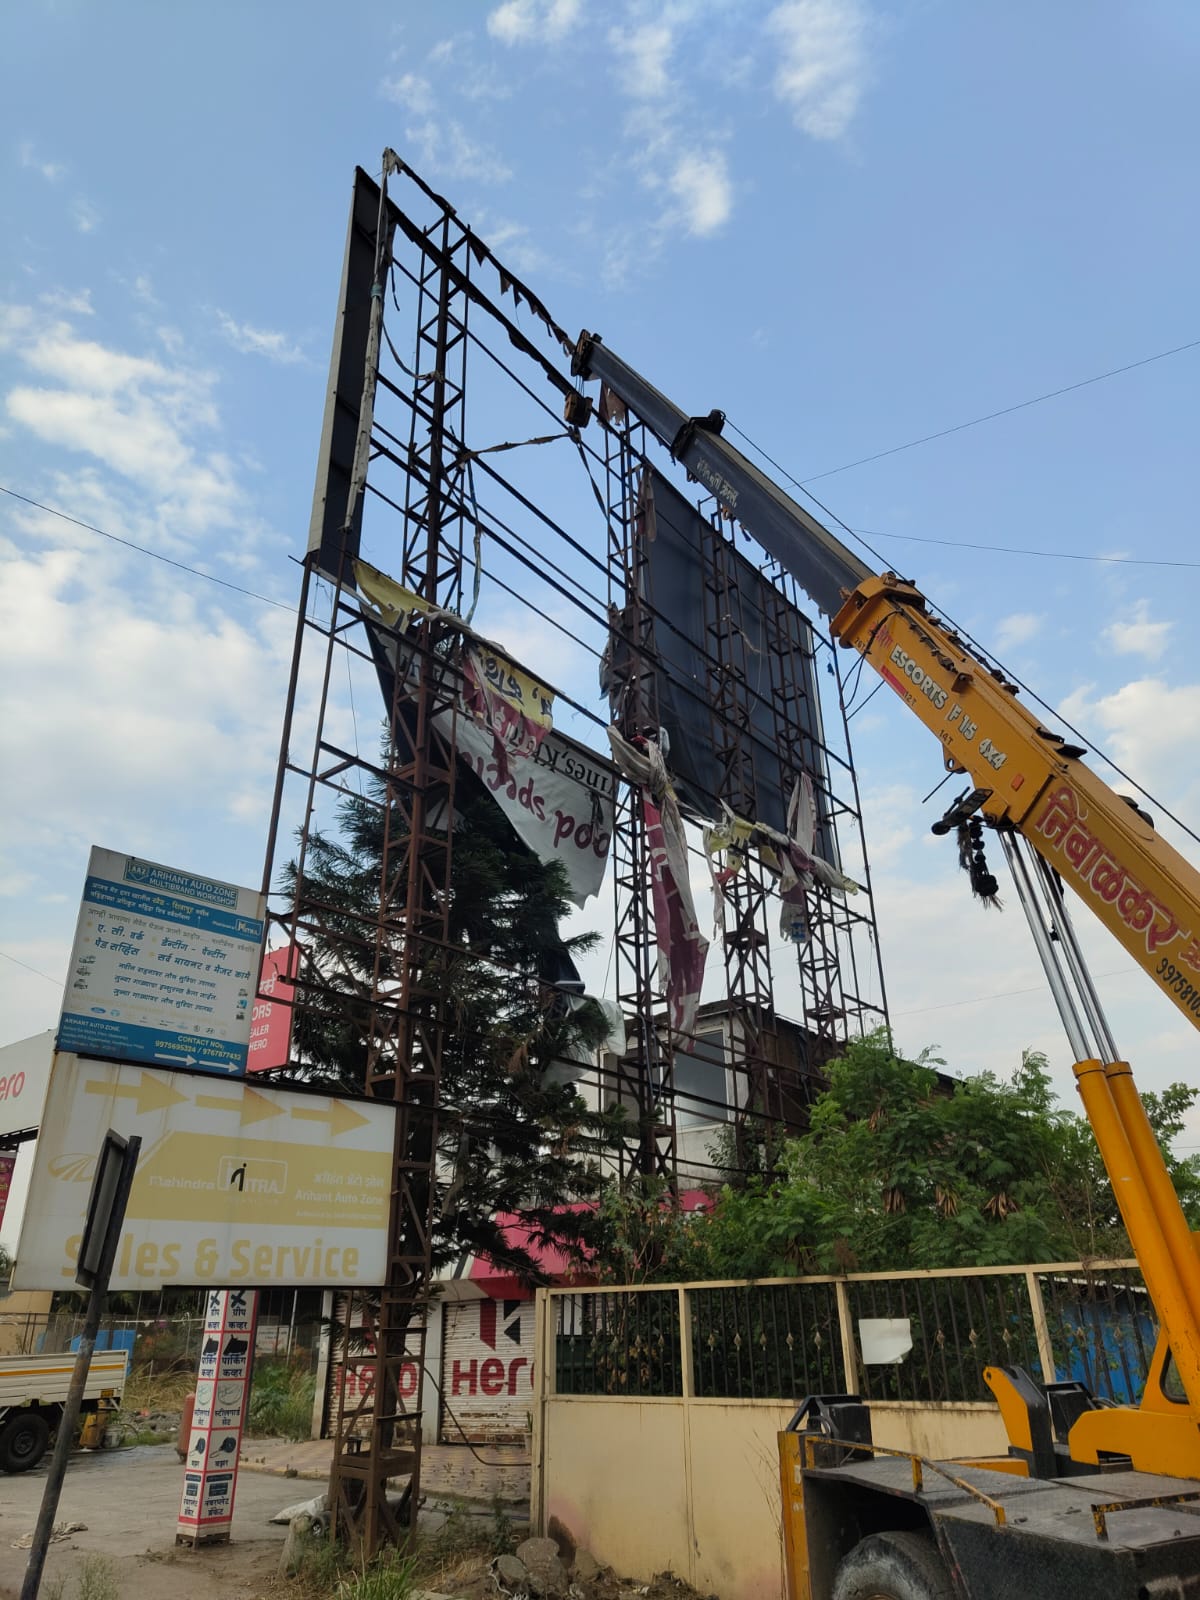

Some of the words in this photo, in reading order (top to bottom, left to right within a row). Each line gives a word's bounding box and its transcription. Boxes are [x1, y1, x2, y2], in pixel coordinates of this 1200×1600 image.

[890, 643, 949, 710] ESCORTS
[945, 703, 963, 722] F
[958, 714, 979, 741] 15
[149, 878, 196, 897] MULTIBRAND
[196, 890, 237, 906] WORKSHOP
[150, 869, 190, 886] ARIHANT
[190, 880, 213, 893] AUTO
[212, 886, 237, 899] ZONE
[178, 1035, 209, 1046] CONTACT
[335, 1191, 358, 1203] Auto
[61, 1232, 181, 1279] Sles
[194, 1238, 219, 1279] &
[229, 1237, 360, 1280] Service
[452, 1357, 534, 1397] Her
